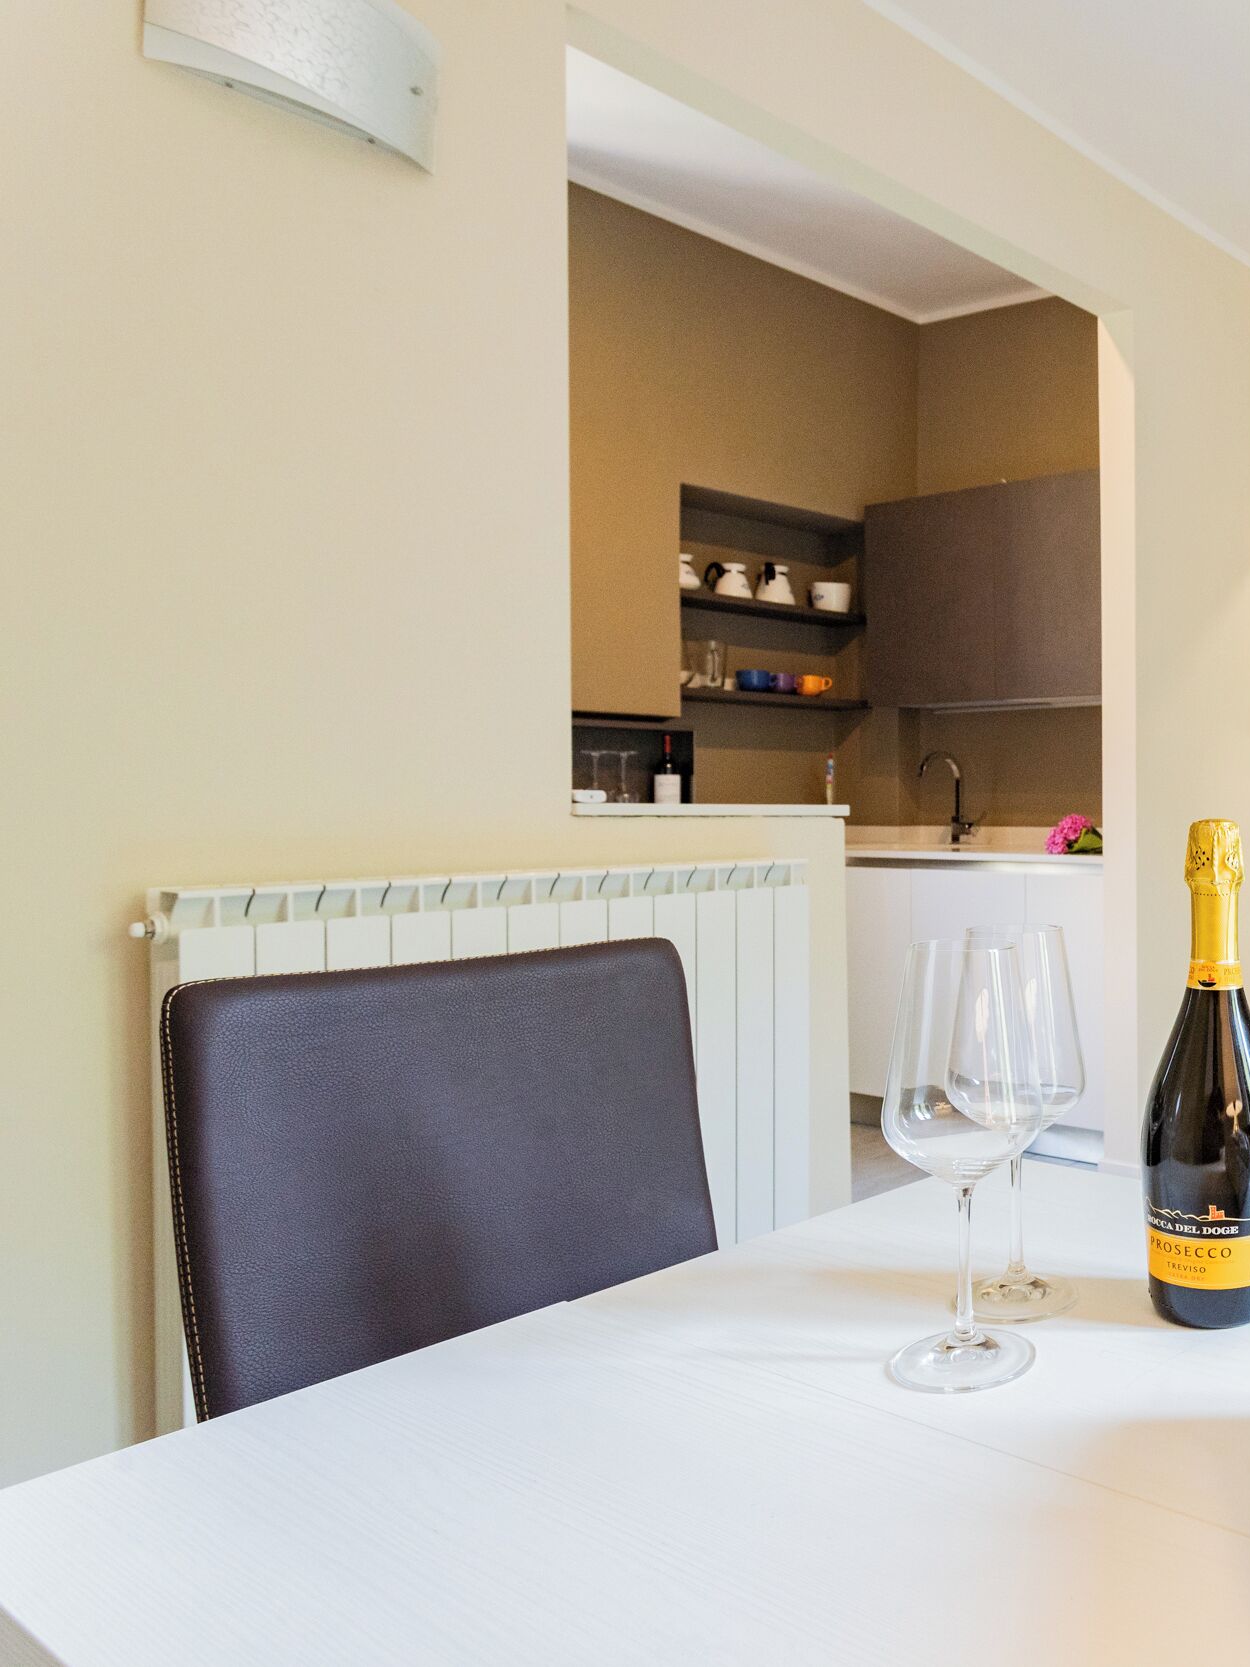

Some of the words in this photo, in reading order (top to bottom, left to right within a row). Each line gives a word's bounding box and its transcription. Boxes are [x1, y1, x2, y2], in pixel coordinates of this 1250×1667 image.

[1175, 1223, 1200, 1235] DEL
[1202, 1226, 1239, 1236] DOGE
[1150, 1235, 1232, 1259] PROSECCO
[1167, 1261, 1206, 1274] TREVISO
